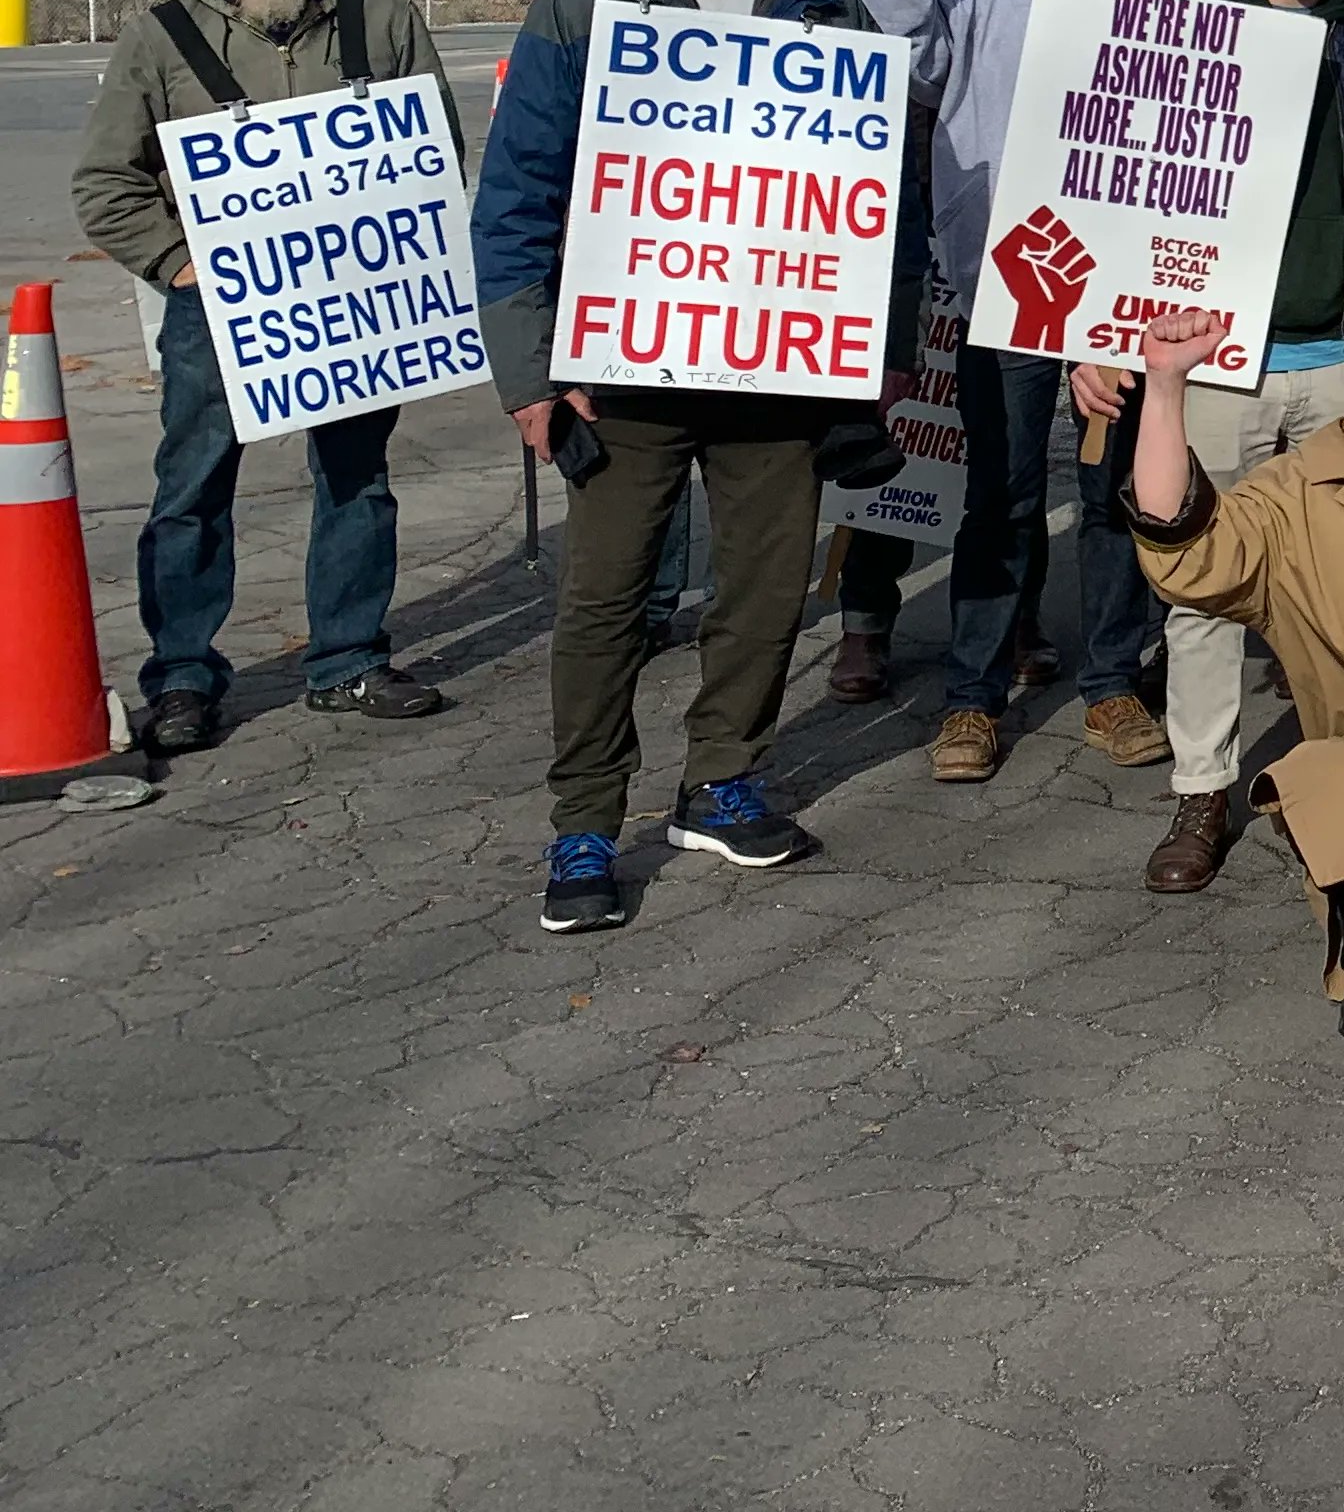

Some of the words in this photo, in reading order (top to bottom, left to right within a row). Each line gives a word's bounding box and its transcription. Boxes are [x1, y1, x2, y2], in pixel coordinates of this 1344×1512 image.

[609, 20, 888, 104] BCTGM
[1190, 1, 1246, 56] NOT
[1090, 43, 1189, 105] ASKING
[1190, 58, 1242, 113] FOR
[179, 91, 431, 182] BCTGM
[596, 85, 733, 135] Local
[751, 101, 889, 152] 374-G
[1059, 90, 1147, 152] MORE...
[1151, 104, 1218, 160] JUST
[1219, 113, 1253, 166] TO
[189, 170, 313, 225] Local
[324, 144, 445, 197] 374-G
[590, 151, 888, 239] FIGHTING
[1060, 147, 1104, 201] ALL
[1107, 154, 1144, 206] BE
[1143, 160, 1235, 220] EQUAL!
[210, 199, 448, 305] SUPPORT
[627, 237, 730, 283] FOR
[747, 247, 841, 292] THE
[1150, 236, 1220, 261] BCTGM
[1152, 254, 1211, 276] LOCAL
[1152, 271, 1206, 292] 374G
[227, 269, 474, 368] ESSENTIAL
[570, 295, 874, 379] FUTURE
[1087, 323, 1249, 371] STG
[244, 327, 486, 425] WORKERS
[601, 364, 635, 379] NO
[687, 372, 758, 390] TIER
[889, 416, 969, 466] CHOICE
[866, 502, 943, 528] STRONG
[879, 486, 938, 508] UNION
